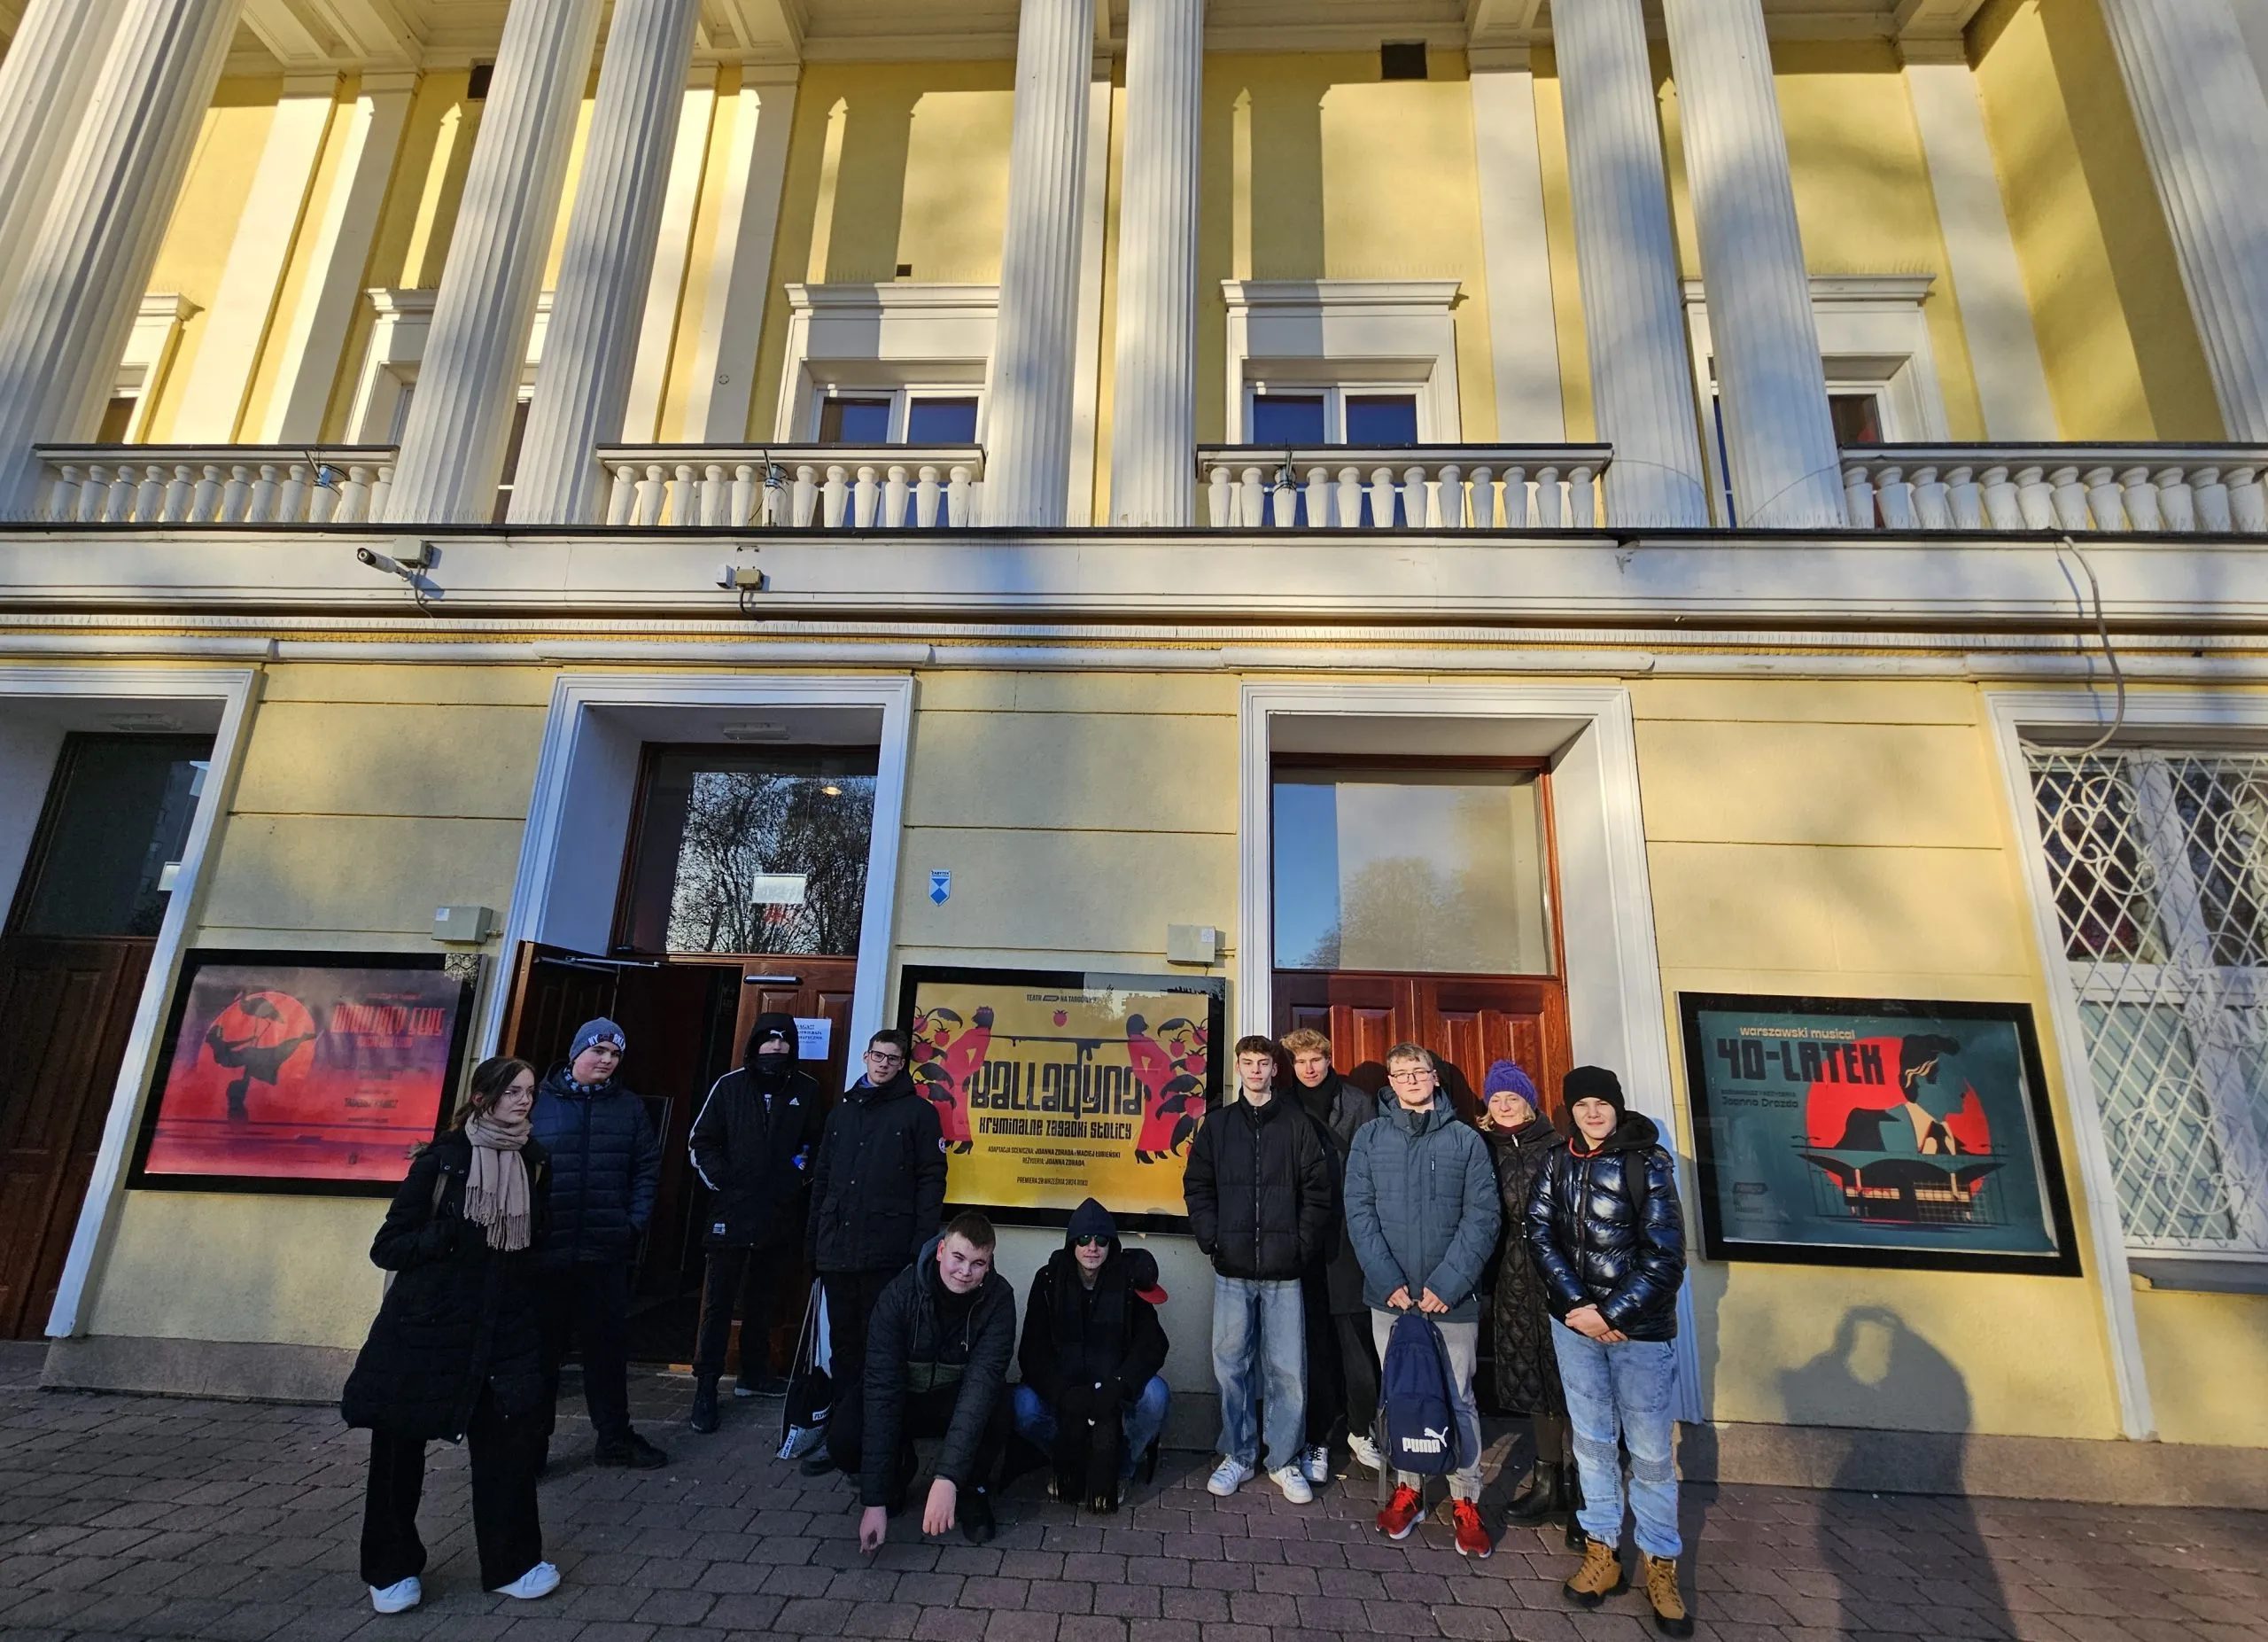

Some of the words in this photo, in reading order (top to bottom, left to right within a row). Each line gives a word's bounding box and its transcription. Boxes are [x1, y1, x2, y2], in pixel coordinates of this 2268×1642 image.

[1739, 1026, 1808, 1039] warszawski
[1811, 1028, 1856, 1039] musical
[1716, 1038, 1885, 1086] 40-LATEK
[1721, 1096, 1759, 1107] Joanna
[1402, 1436, 1441, 1453] PUMA
